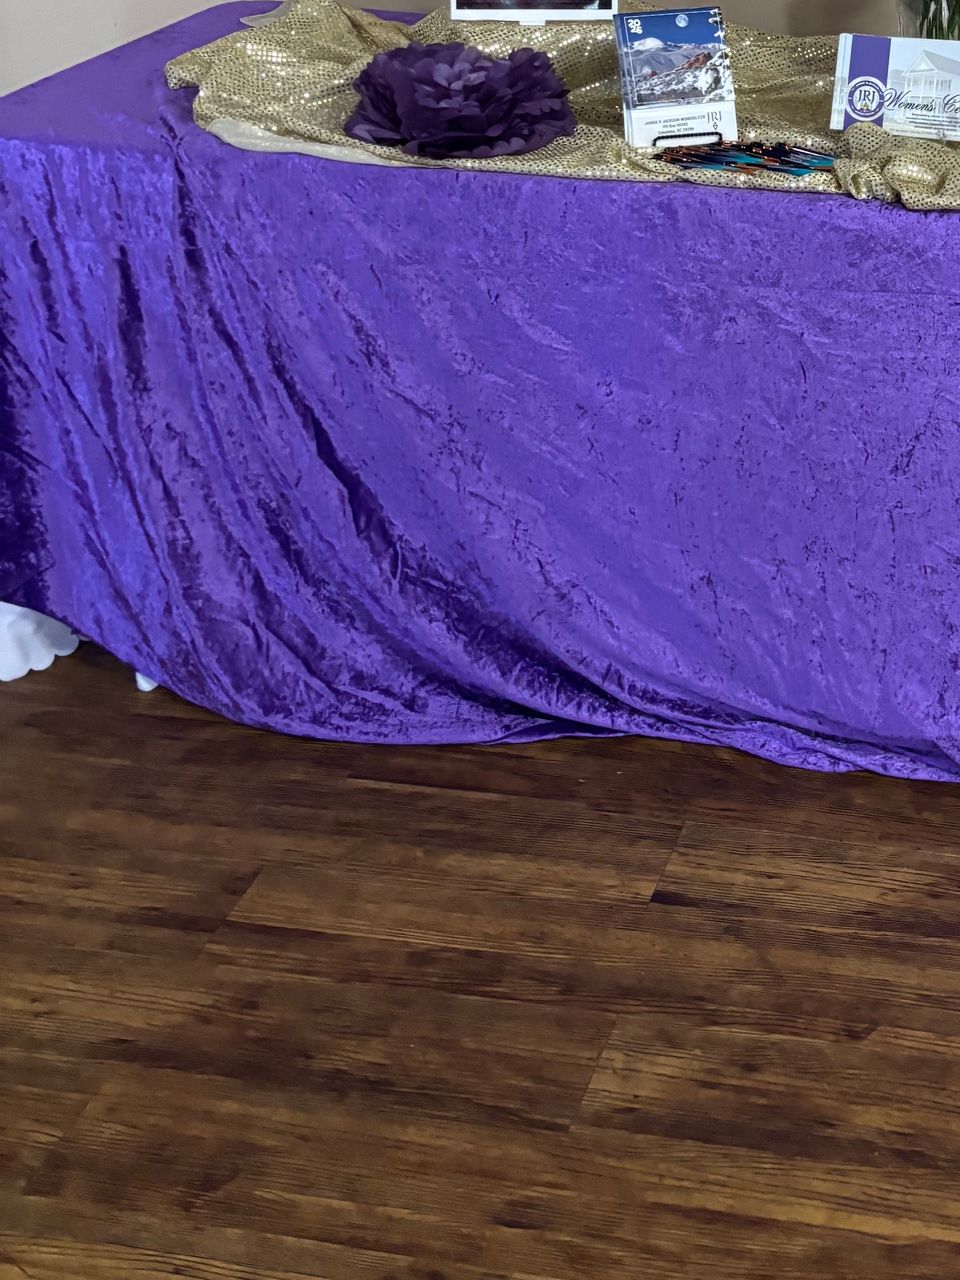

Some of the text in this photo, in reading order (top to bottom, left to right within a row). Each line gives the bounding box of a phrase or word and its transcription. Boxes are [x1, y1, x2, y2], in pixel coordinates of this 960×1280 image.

[630, 26, 642, 34] 26
[858, 90, 876, 105] JRJ
[883, 88, 936, 112] Women's
[707, 111, 721, 124] JRJ
